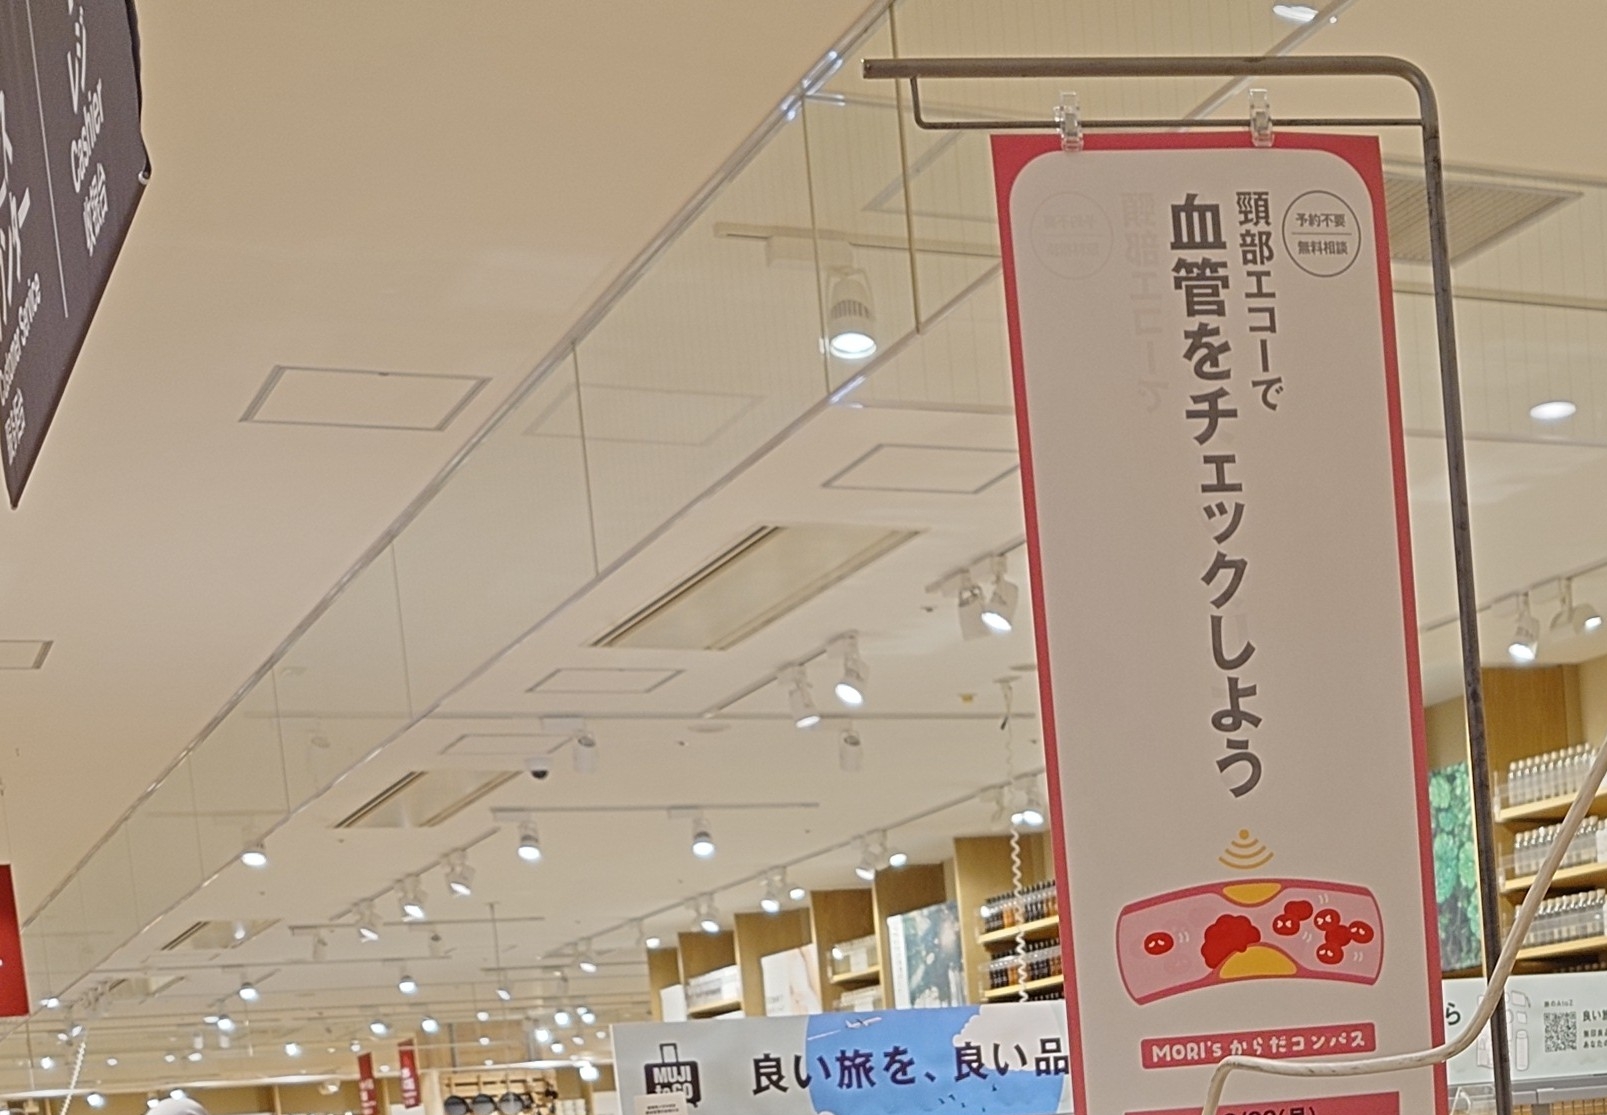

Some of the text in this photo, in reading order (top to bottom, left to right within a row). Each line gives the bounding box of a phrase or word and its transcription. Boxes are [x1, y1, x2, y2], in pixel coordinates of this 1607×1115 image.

[66, 5, 87, 115] レジ
[70, 77, 104, 194] Cashier
[1295, 212, 1346, 228] 予約不要
[1298, 240, 1348, 255] 無料相談
[18, 272, 41, 347] Service
[1235, 189, 1286, 412] 頸部エコーで
[1169, 192, 1265, 800] 血管をチェックしよう
[653, 1065, 692, 1084] MUJI
[751, 1038, 1070, 1096] 良い旅を、良い品
